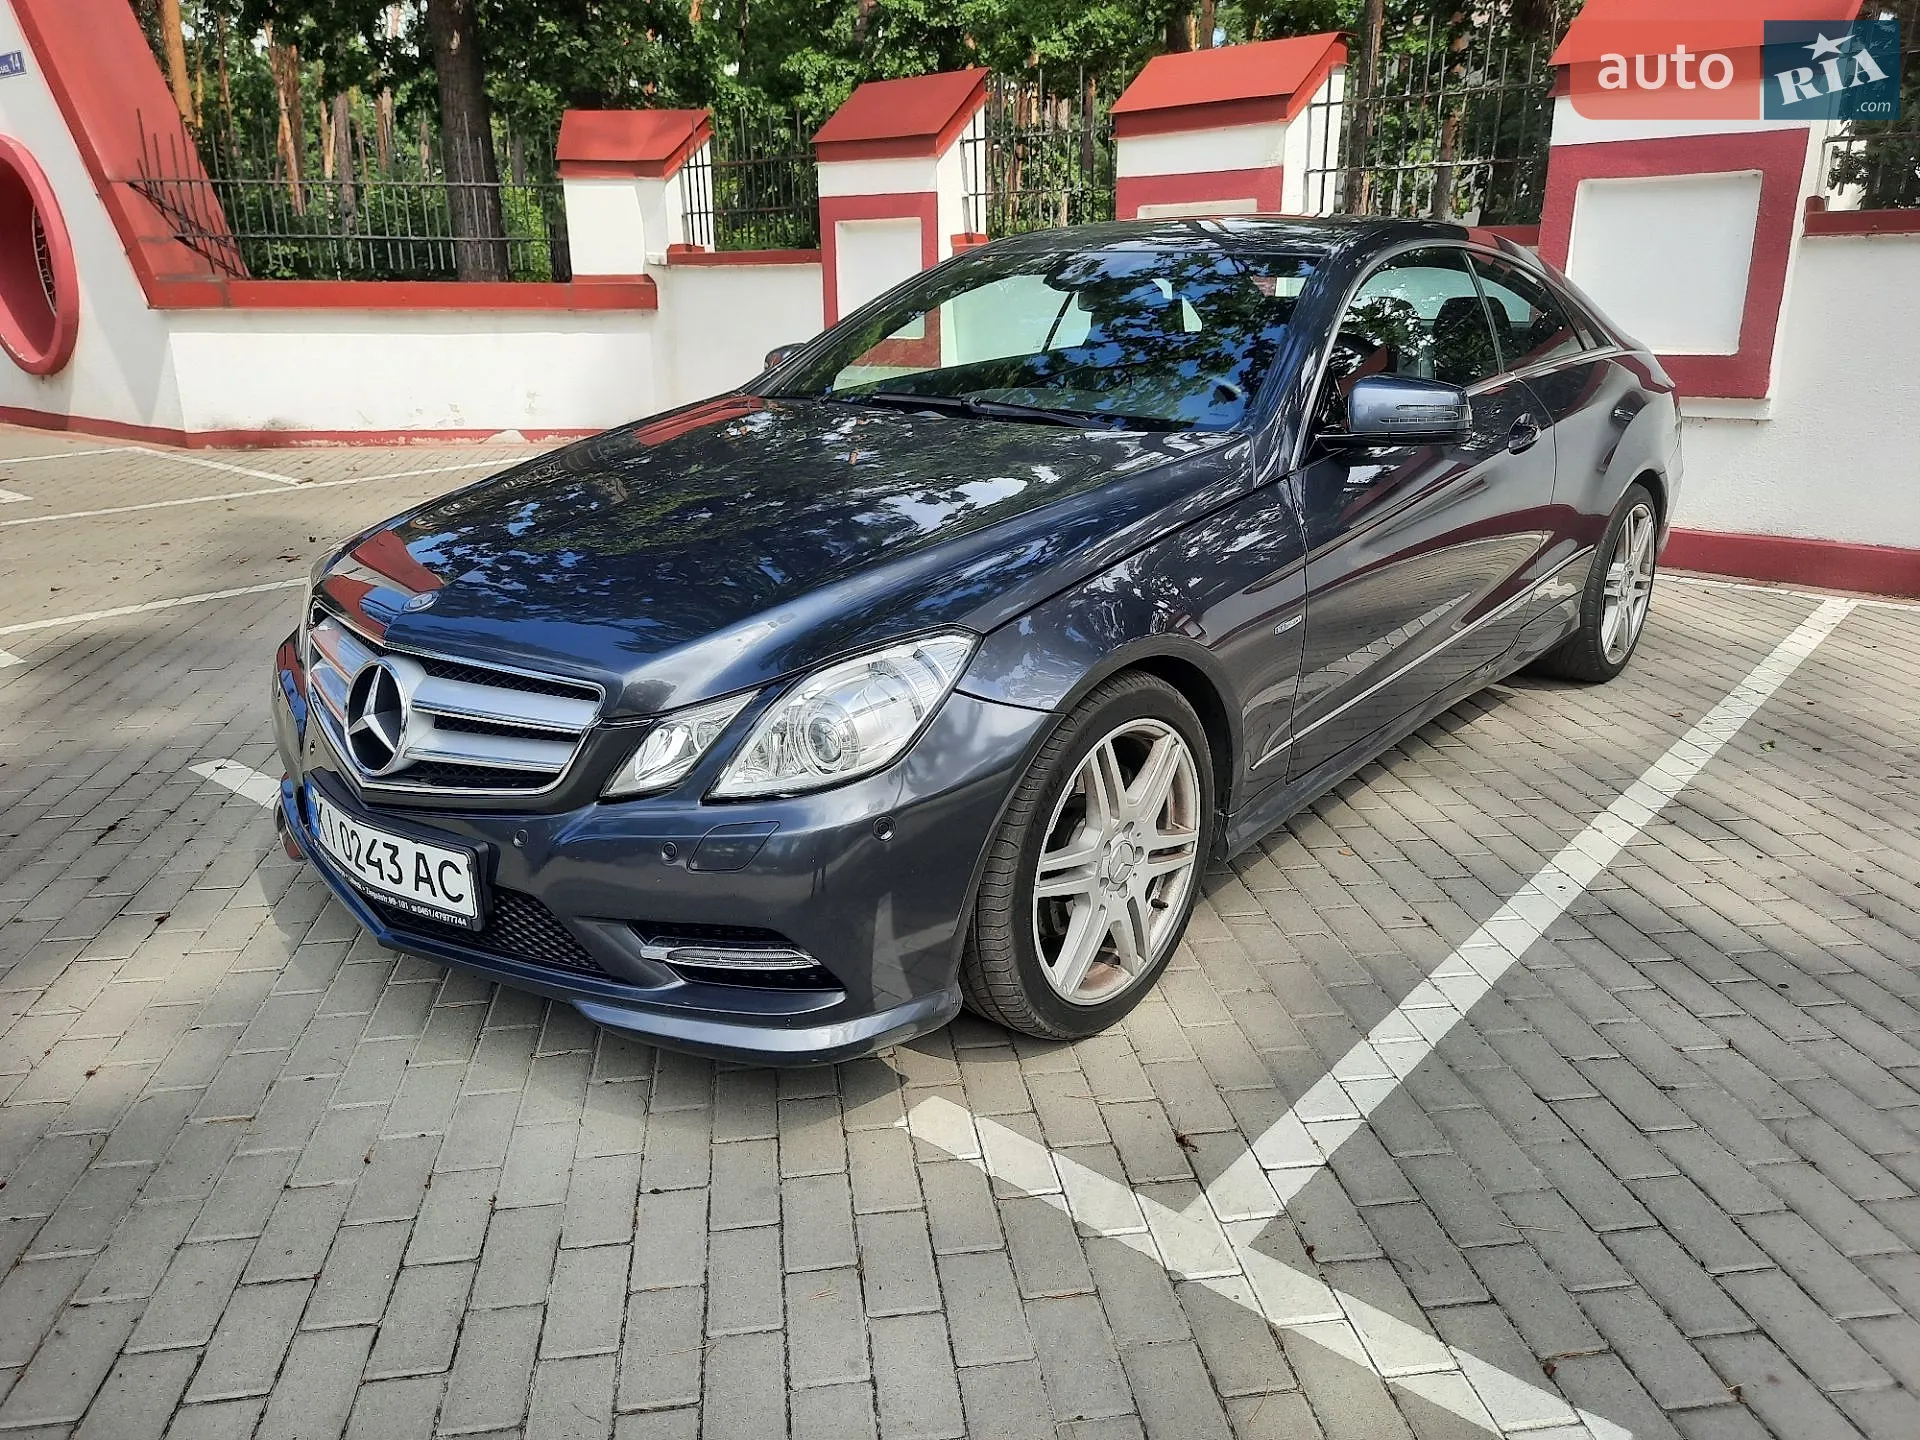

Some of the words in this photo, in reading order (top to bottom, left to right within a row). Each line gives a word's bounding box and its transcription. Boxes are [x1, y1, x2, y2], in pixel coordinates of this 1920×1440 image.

[10, 53, 21, 71] 14
[339, 820, 403, 885] 0243
[414, 851, 464, 903] AC
